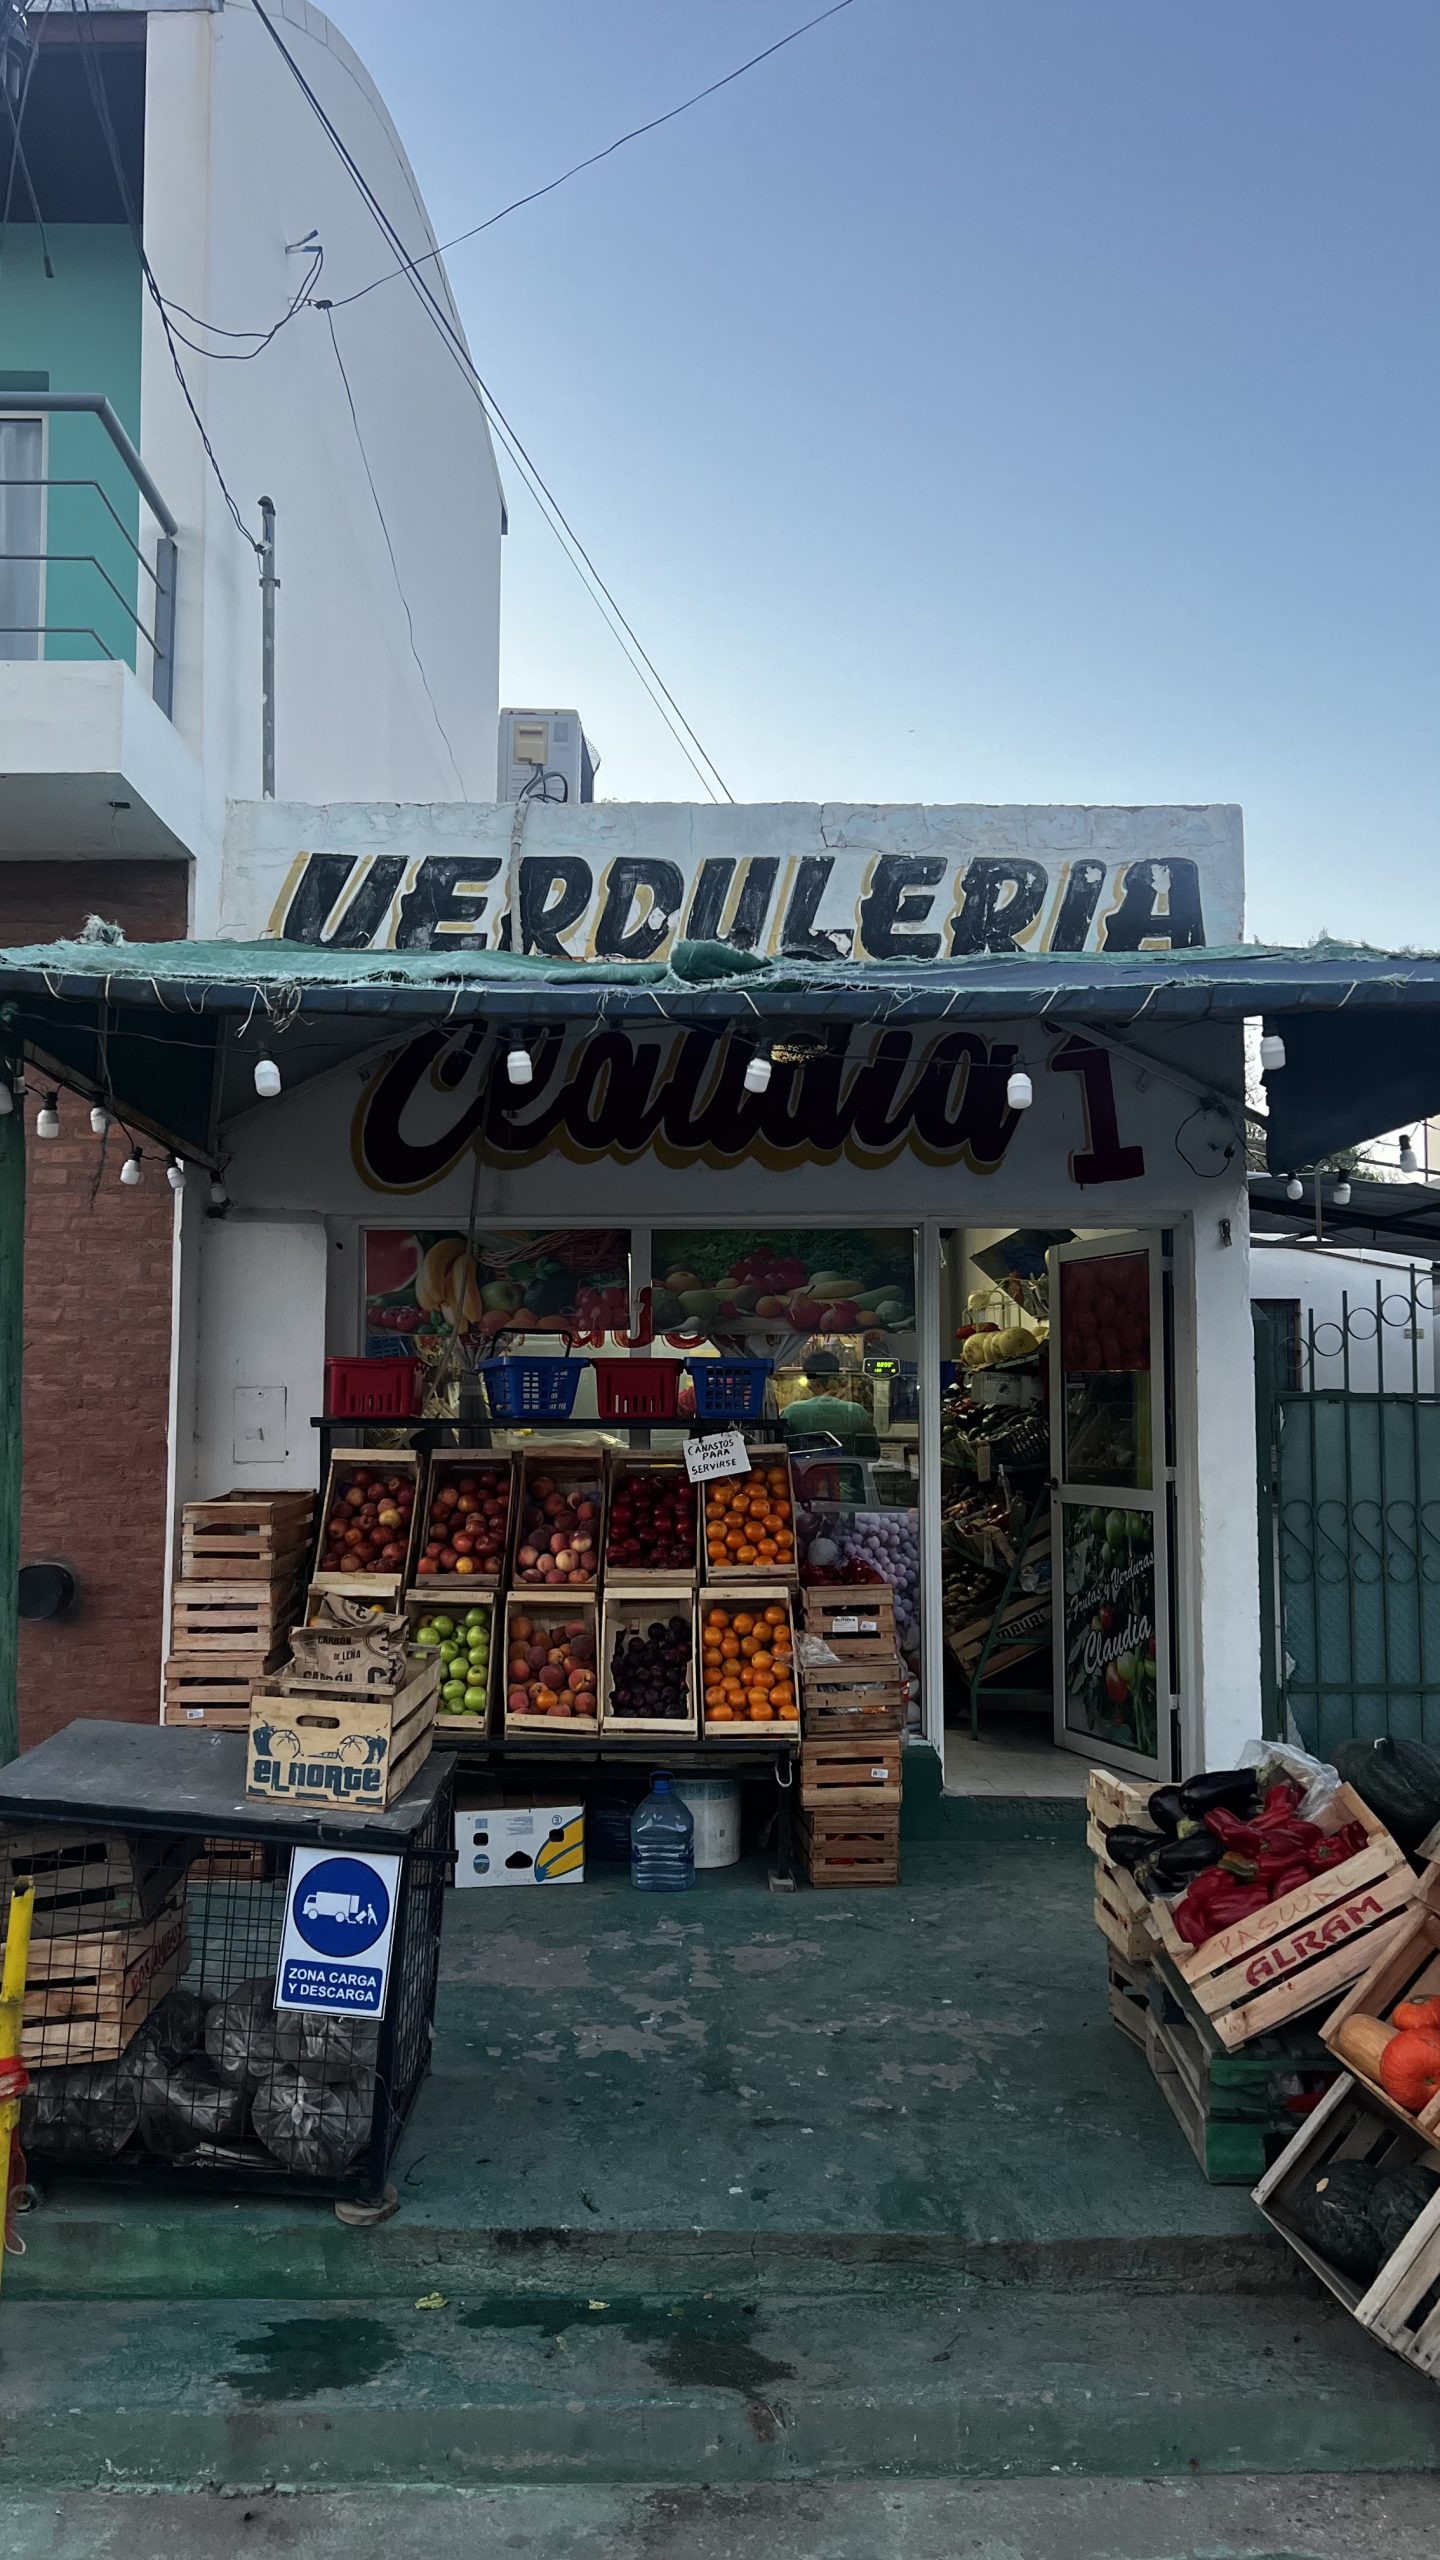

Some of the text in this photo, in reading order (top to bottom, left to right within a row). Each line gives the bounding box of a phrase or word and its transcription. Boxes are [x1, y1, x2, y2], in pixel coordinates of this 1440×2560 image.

[272, 851, 1207, 962] VERDULERIA
[353, 1020, 1146, 1192] Claudia 1
[688, 1439, 734, 1456] CANASTOS
[702, 1449, 730, 1460] PARA
[1070, 1587, 1102, 1620] Frutas
[1110, 1552, 1155, 1590] Verduras
[342, 1648, 361, 1661] LEÑA
[1083, 1613, 1152, 1674] Claudia
[1245, 1896, 1383, 1987] ALRAM
[288, 1967, 377, 1988] ZONA CARGA
[288, 1983, 375, 2003] Y DESCARGA
